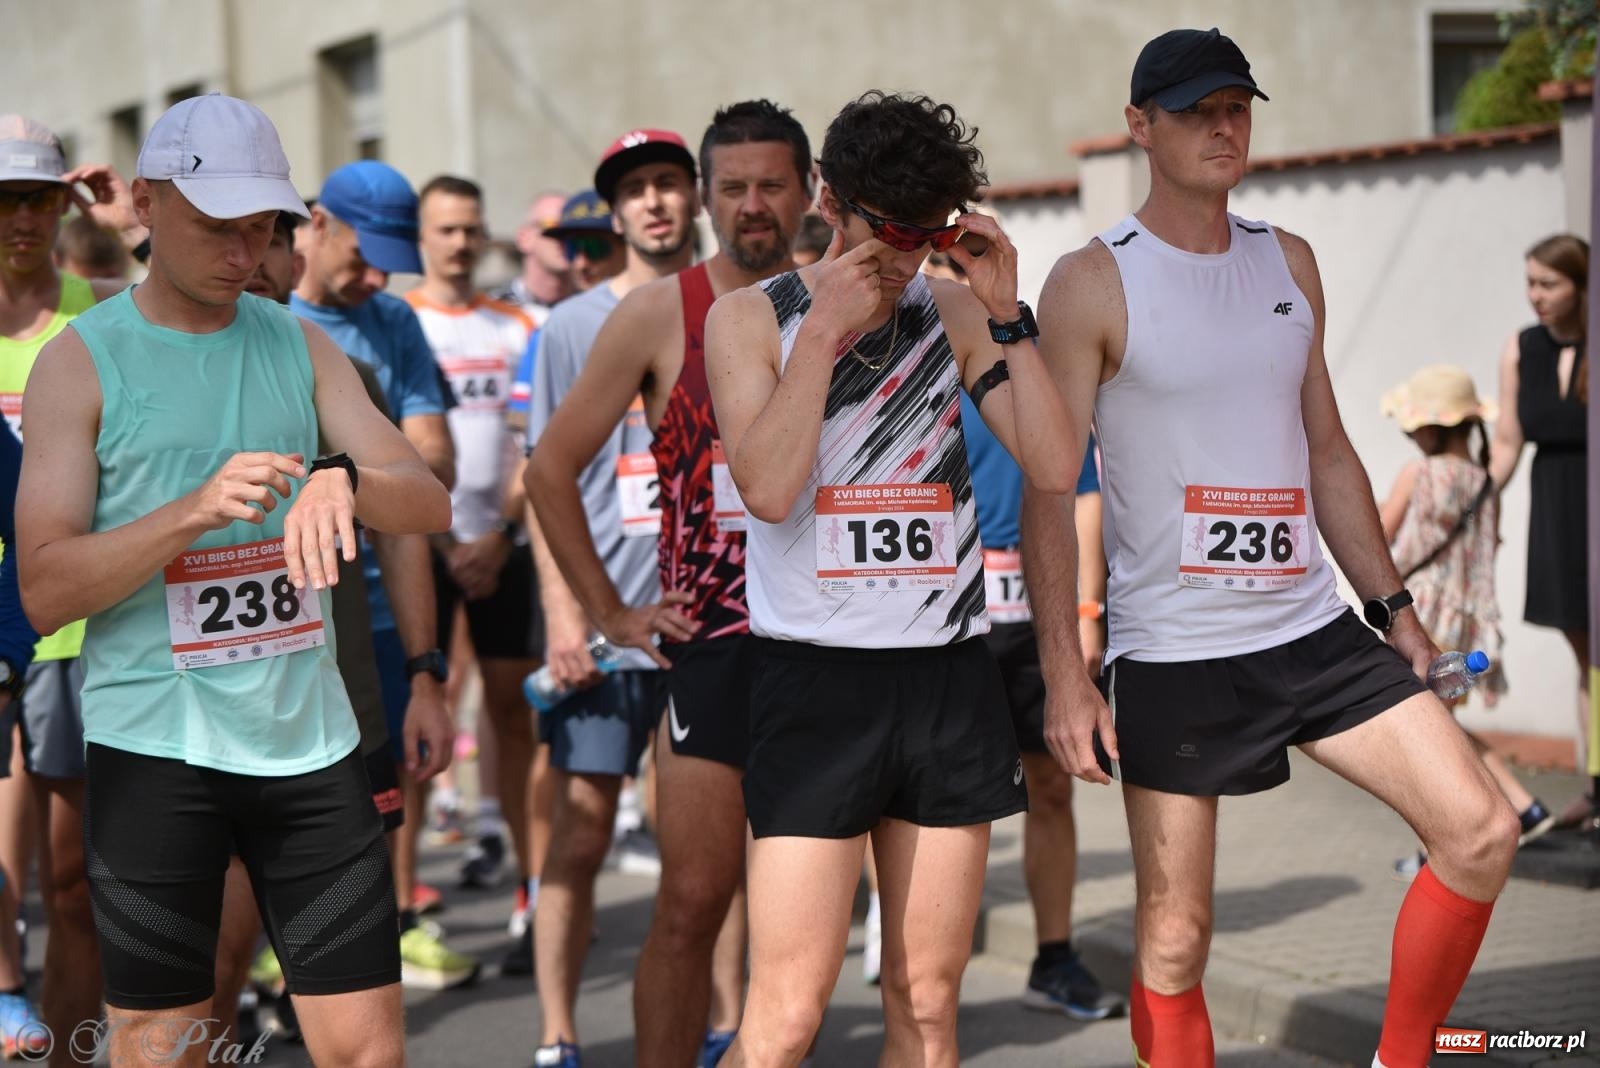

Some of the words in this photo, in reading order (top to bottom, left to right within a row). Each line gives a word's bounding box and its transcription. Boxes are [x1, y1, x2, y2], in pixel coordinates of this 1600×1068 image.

[1274, 302, 1293, 316] 4F
[462, 377, 498, 397] 44
[833, 490, 853, 500] XVI
[855, 489, 881, 498] BIEG
[882, 488, 902, 498] BEZ
[903, 488, 938, 498] GRANIC
[1202, 490, 1222, 500] XVI
[1223, 491, 1248, 501] BIEG
[1249, 492, 1267, 502] BEZ
[1268, 492, 1295, 502] GRANIC
[847, 518, 933, 563] 136
[1207, 520, 1293, 564] 236
[184, 556, 206, 566] XVI
[207, 552, 236, 563] BIEG
[238, 548, 259, 559] BEZ
[260, 542, 285, 554] GRA
[999, 576, 1025, 601] 17
[198, 574, 300, 634] 238
